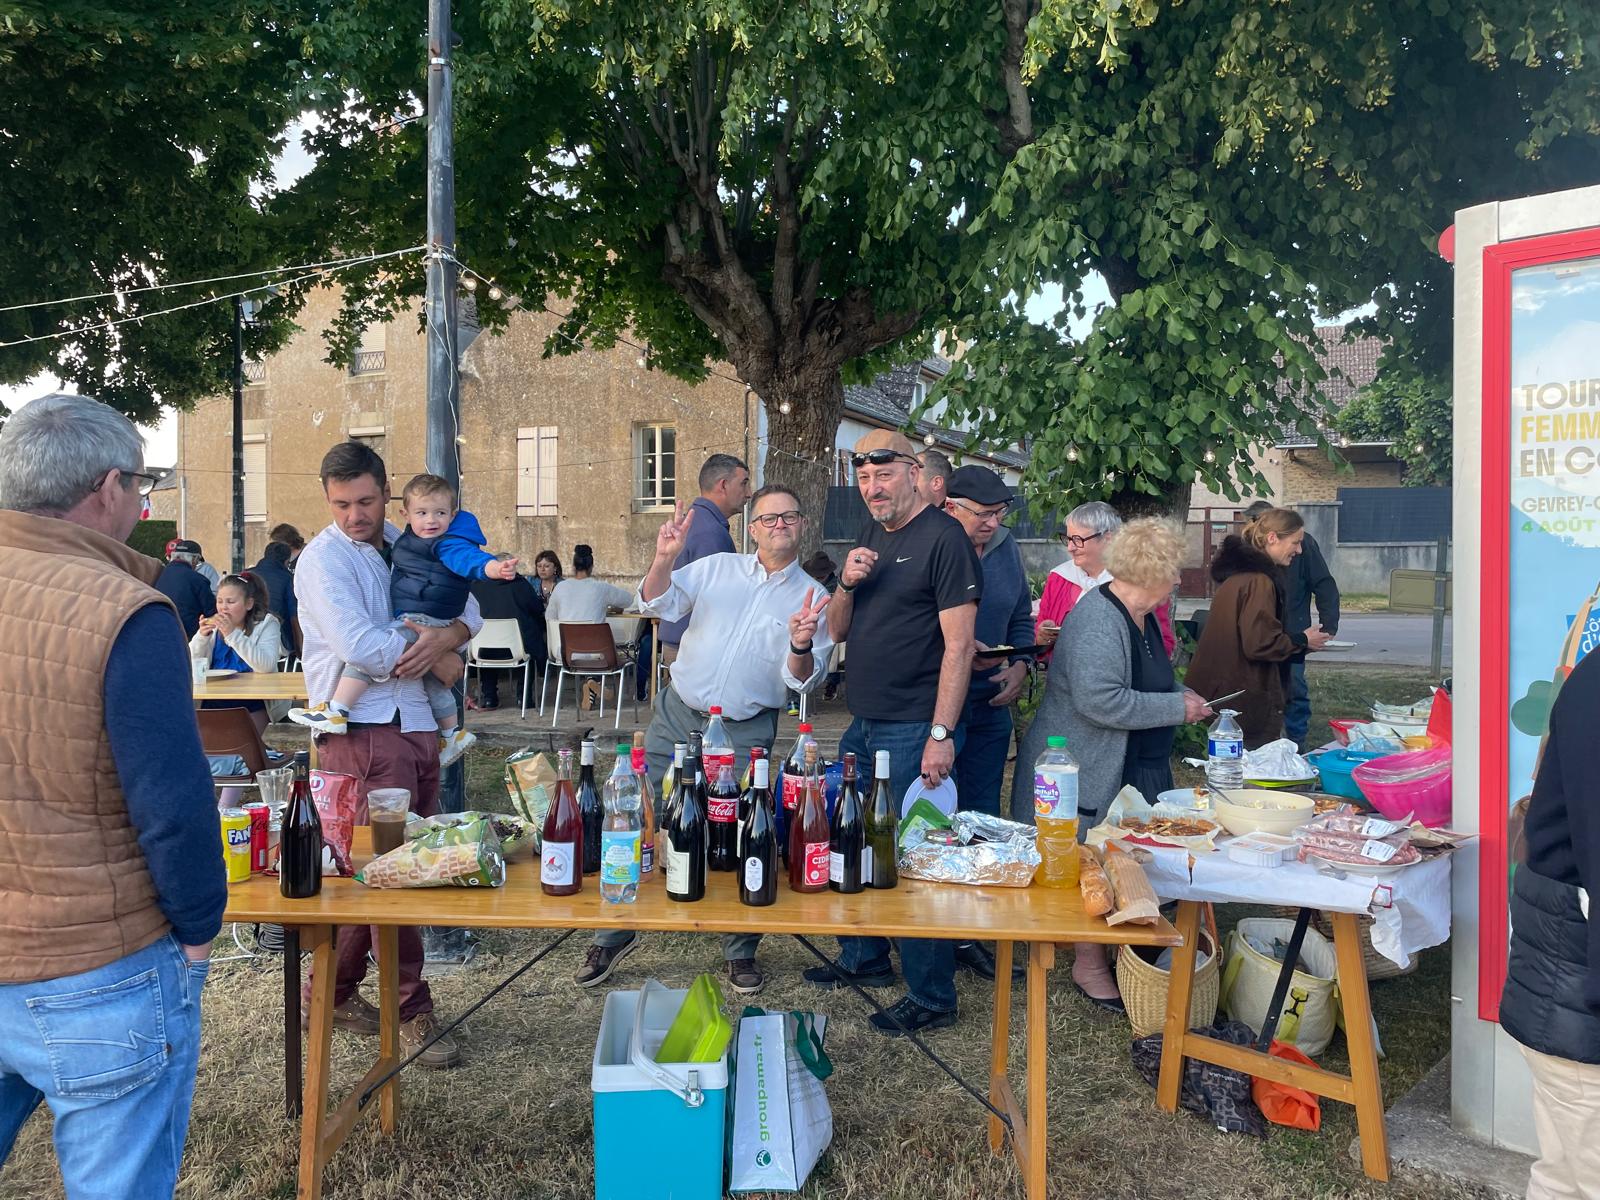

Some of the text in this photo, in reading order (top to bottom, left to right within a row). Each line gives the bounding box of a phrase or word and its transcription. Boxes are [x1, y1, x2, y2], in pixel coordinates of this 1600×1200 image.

[1520, 411, 1600, 444] FEMM
[1520, 446, 1600, 477] EN C
[1521, 516, 1596, 534] 4 AOÛT
[754, 1034, 770, 1141] groupama.fr
